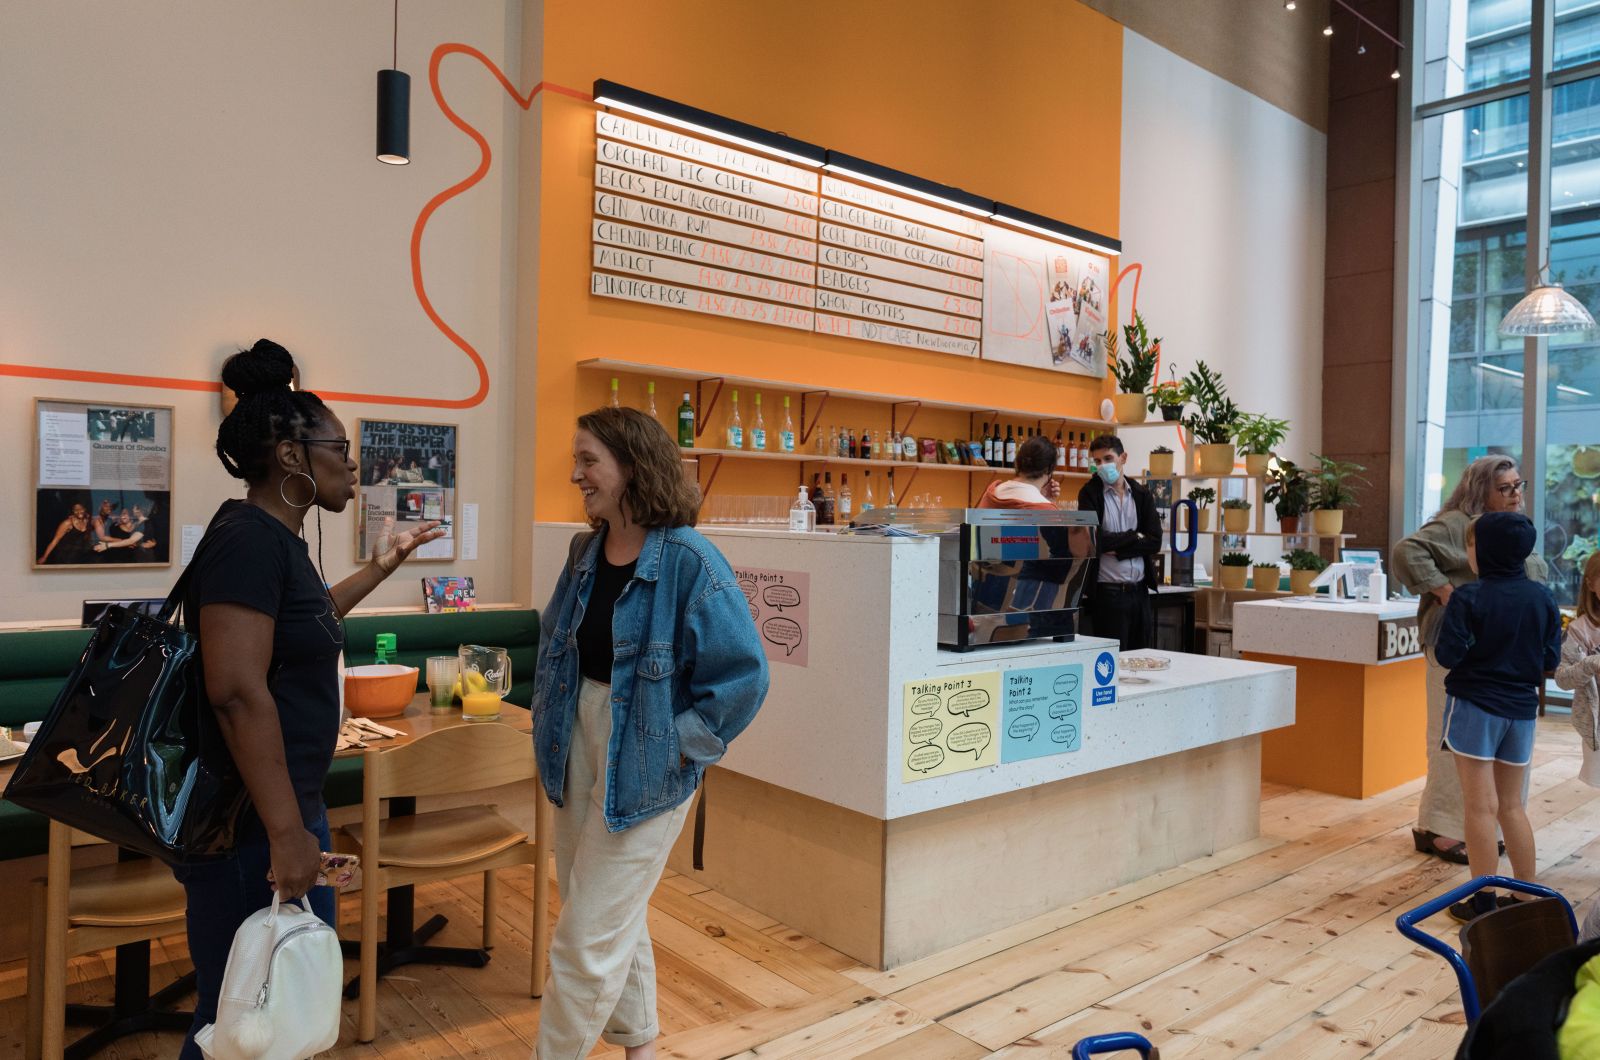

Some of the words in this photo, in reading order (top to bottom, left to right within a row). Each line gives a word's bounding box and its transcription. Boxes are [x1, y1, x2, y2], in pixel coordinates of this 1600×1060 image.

[602, 141, 668, 174] ORCHARD
[680, 161, 705, 183] PIG
[714, 171, 755, 195] CIDER
[599, 167, 645, 194] BECKS
[654, 181, 686, 204] BLUE
[822, 199, 869, 226] GINGER
[687, 215, 711, 236] RUM
[597, 221, 650, 249] CHENIN
[656, 233, 696, 258] BLANC
[600, 249, 654, 274] MERLOT
[825, 246, 869, 272] CRISPS
[593, 273, 655, 302] PINOTAGE
[659, 286, 688, 306] ROSE
[822, 269, 871, 294] BADGES
[819, 291, 851, 312] SHOW
[861, 300, 904, 321] POSTERS
[370, 433, 395, 446] THE
[398, 434, 445, 449] RIPPER
[418, 425, 450, 436] STOP
[736, 571, 758, 582] Talking
[760, 573, 777, 582] Point
[1384, 622, 1420, 658] BOX
[912, 684, 942, 695] Talking
[944, 680, 964, 690] Point
[968, 680, 972, 688] 3
[1010, 676, 1032, 686] Talking
[1010, 688, 1026, 697] Point
